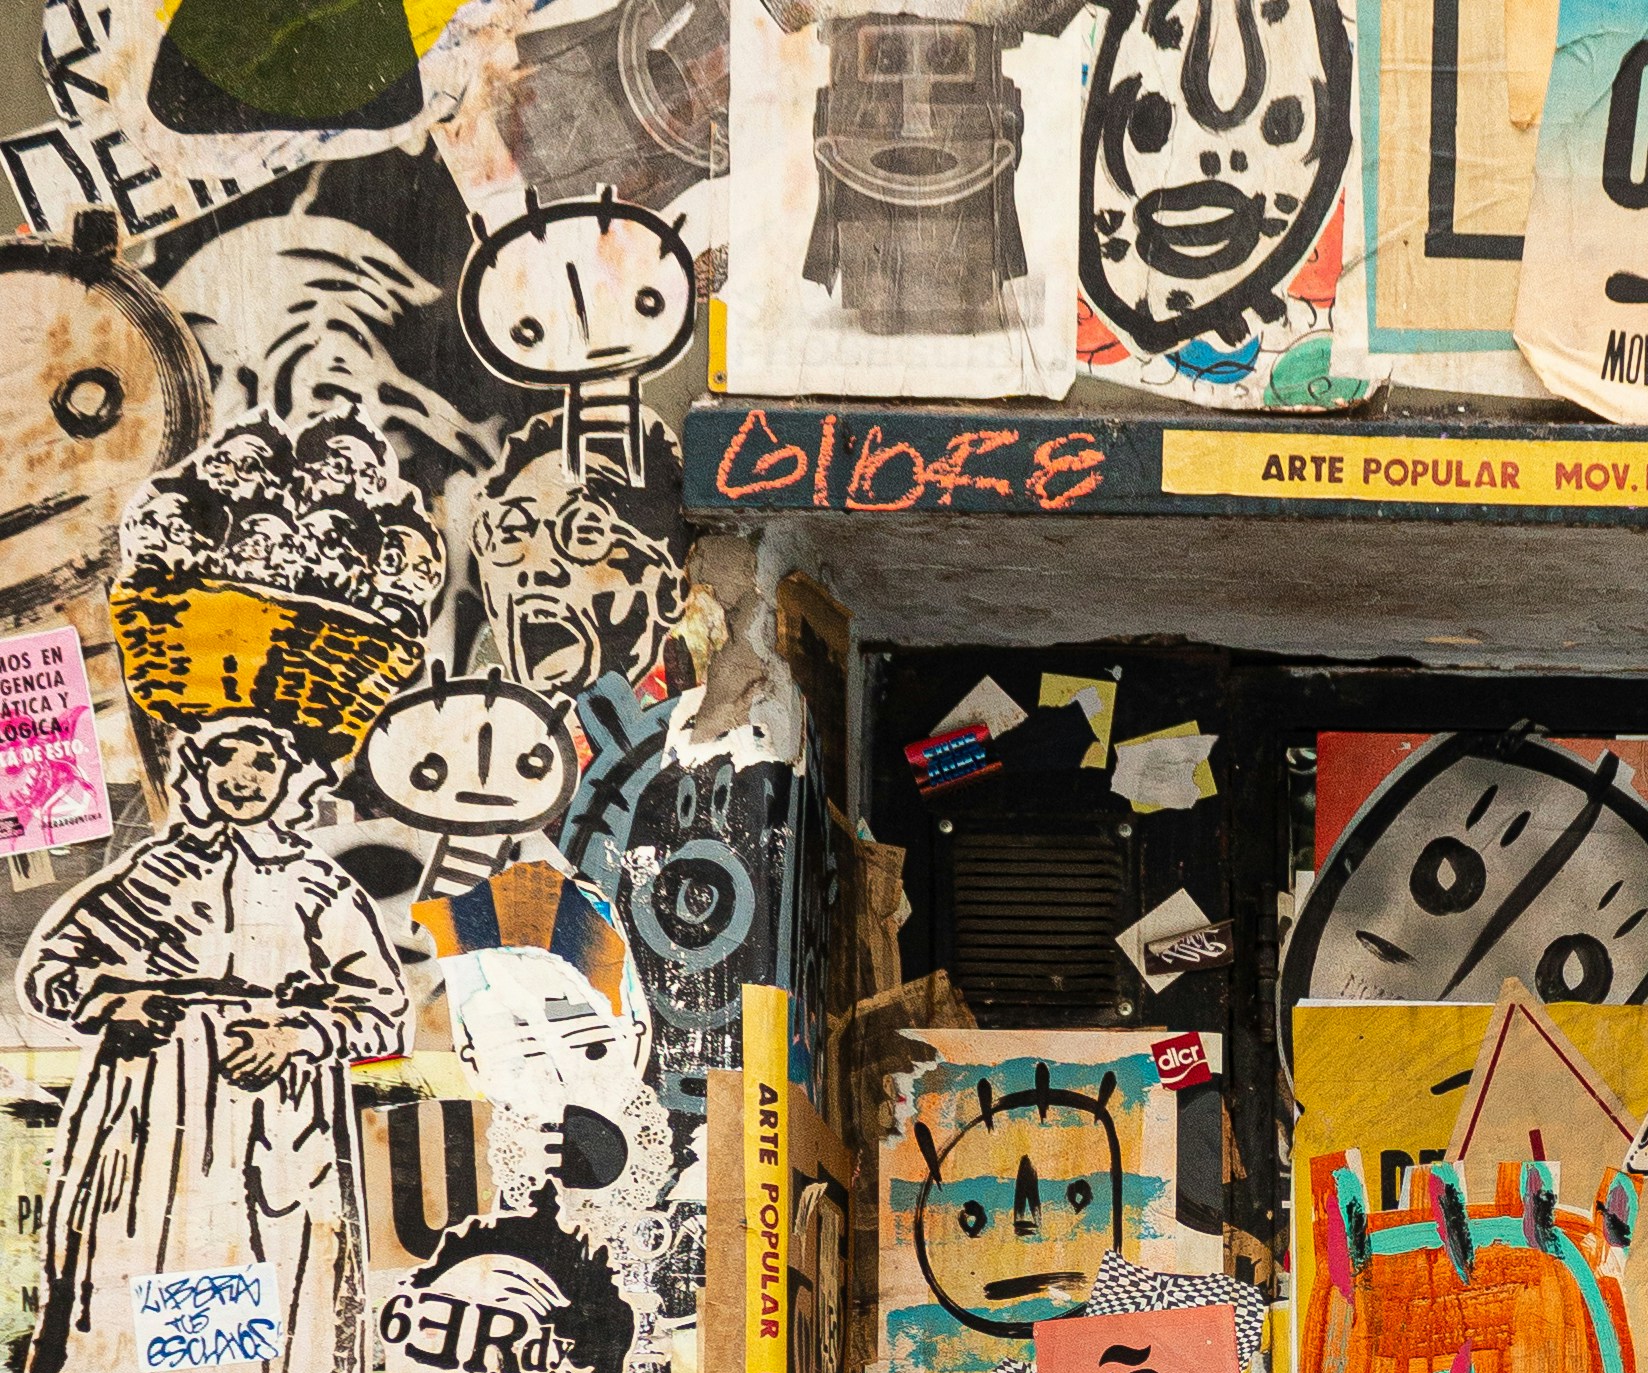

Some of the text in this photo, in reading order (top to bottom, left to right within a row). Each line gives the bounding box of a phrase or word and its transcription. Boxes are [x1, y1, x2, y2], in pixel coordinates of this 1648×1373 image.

[1262, 453, 1343, 484] ARTE
[1364, 458, 1520, 489] POPULAR
[41, 645, 63, 666] EN
[58, 691, 70, 710] Y
[21, 746, 42, 764] DE
[1158, 1044, 1199, 1070] dlcr
[759, 1083, 778, 1165] ARTE
[757, 1186, 779, 1338] POPULAR
